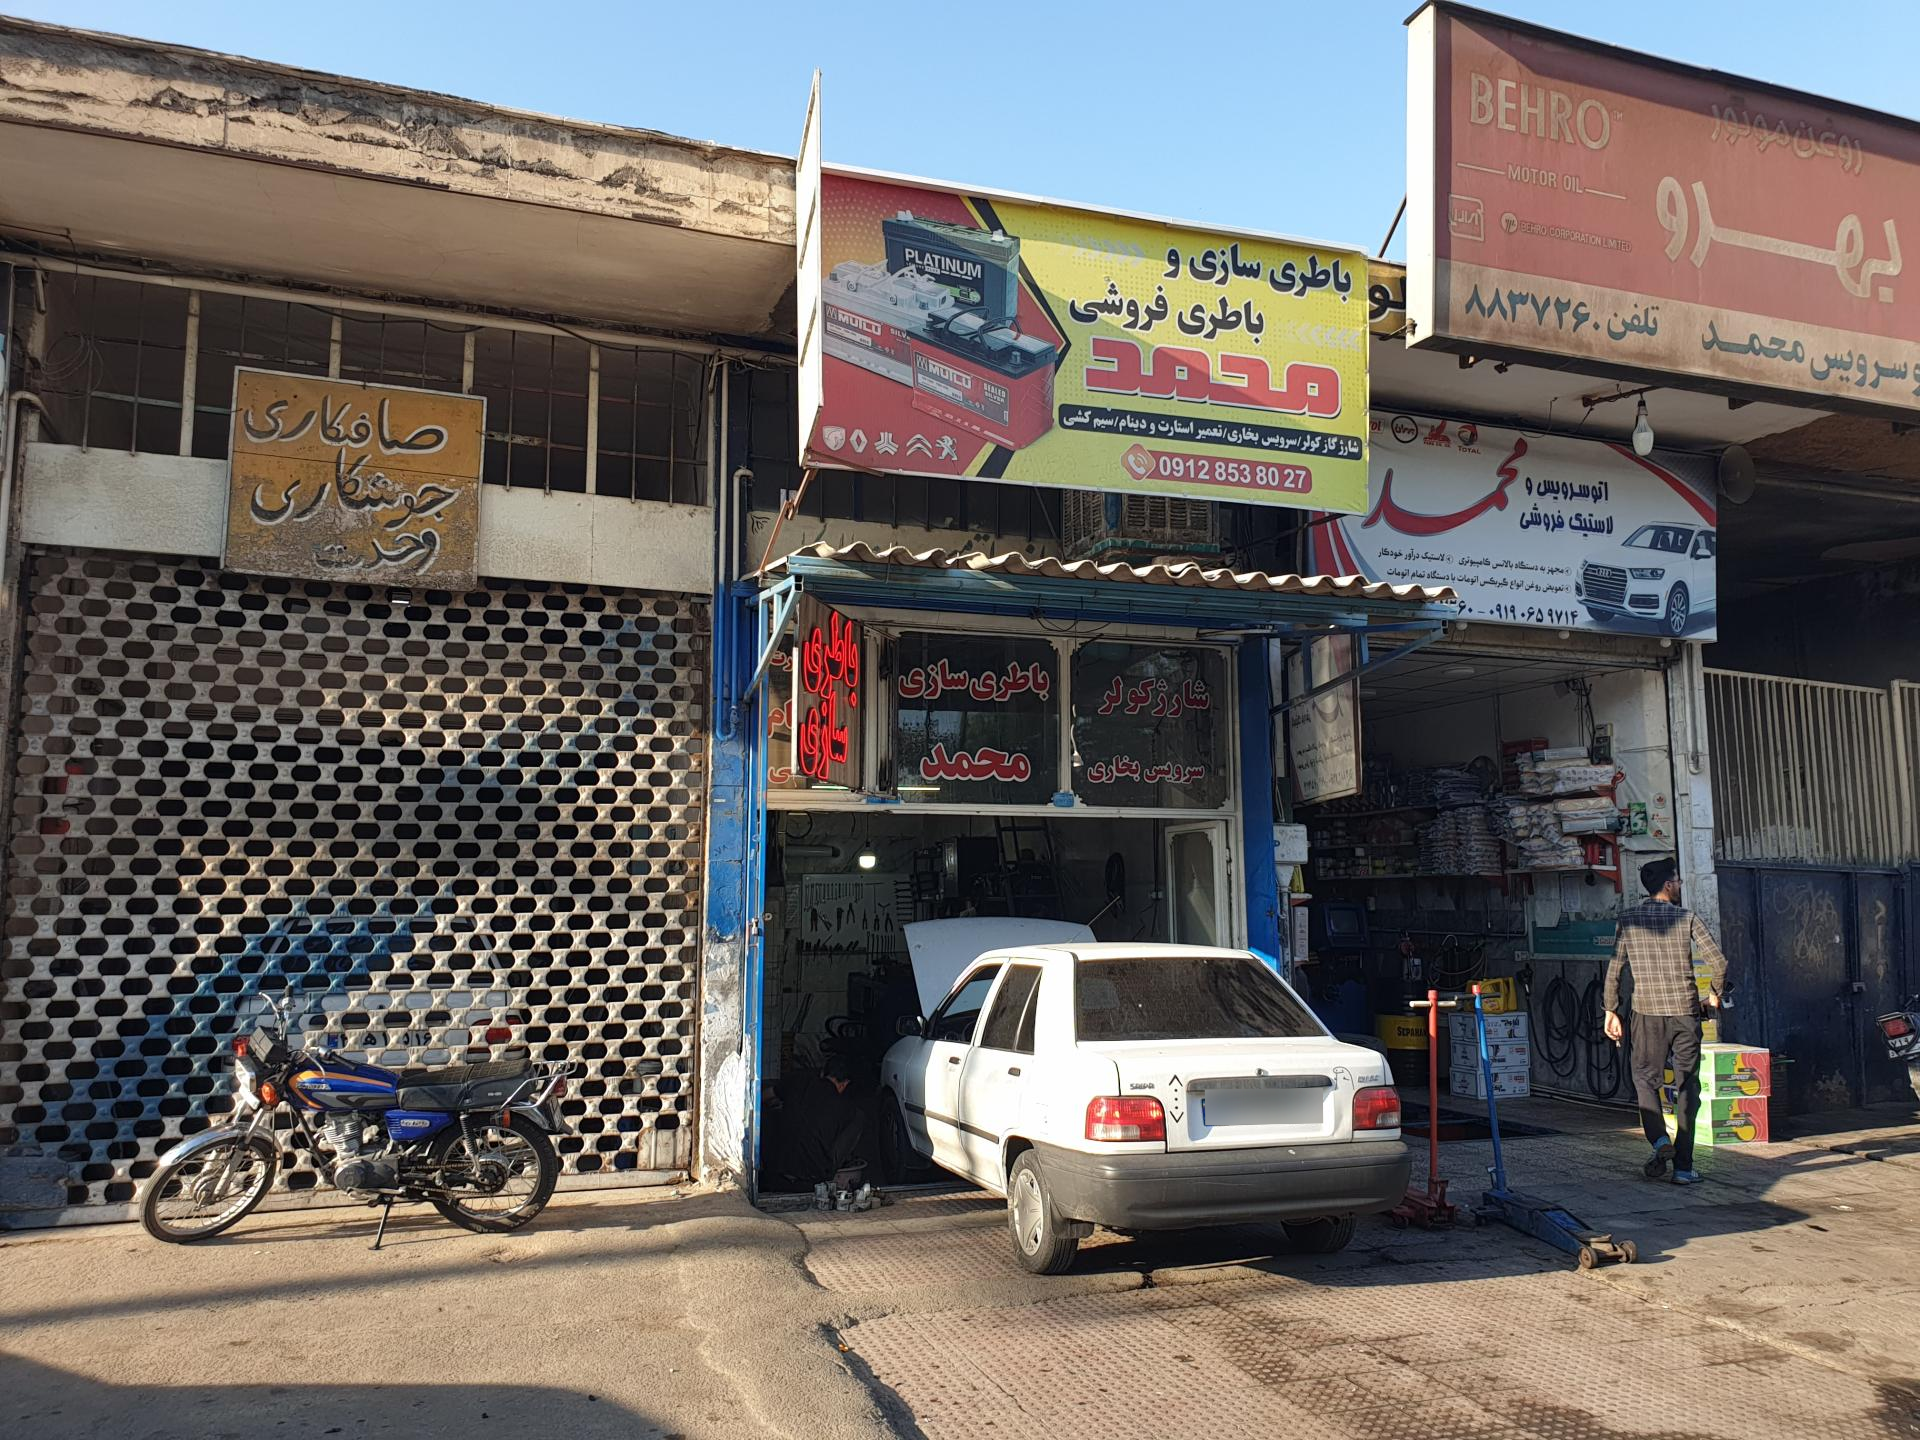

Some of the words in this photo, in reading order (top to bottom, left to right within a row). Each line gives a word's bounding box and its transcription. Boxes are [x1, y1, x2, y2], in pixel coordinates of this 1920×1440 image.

[1470, 72, 1610, 150] BEHRO
[1507, 164, 1557, 188] MOTOR
[1563, 175, 1584, 194] OIL
[1519, 221, 1548, 236] BEHRO
[1550, 227, 1602, 247] CORPORATION
[1602, 237, 1633, 253] LIMITED
[1656, 176, 1903, 304] بهرو
[904, 248, 982, 280] PLATINUM
[1163, 247, 1181, 278] و
[1188, 242, 1262, 286] سازی
[1269, 252, 1352, 303] باطری
[1069, 281, 1170, 332] فروشی
[1176, 295, 1265, 345] باطری
[1607, 304, 1660, 341] تلفن
[1701, 319, 1806, 366] محمد
[1084, 336, 1342, 418] محمد
[243, 394, 449, 456] صافکاری
[1063, 409, 1092, 426] کشی
[1150, 423, 1156, 435] و
[1158, 420, 1194, 436] استارت
[1322, 436, 1337, 453] گاز
[1338, 440, 1359, 456] شارژ
[1458, 446, 1481, 455] TOTAL
[250, 447, 460, 531] جوشکاری
[1159, 455, 1210, 480] 0912
[1214, 461, 1251, 484] 853
[1255, 465, 1280, 486] 80
[1283, 469, 1307, 489] 27
[1361, 437, 1528, 537] محمد
[1525, 477, 1533, 497] و
[1519, 503, 1564, 530] فروشی
[1569, 511, 1614, 537] لاستیک
[314, 528, 440, 576] وحدت
[1421, 551, 1445, 562] لاستیک
[1514, 560, 1539, 572] دستگاه
[1489, 603, 1516, 622] ۰۹۱۹
[1520, 607, 1544, 623] ۰۶۵
[803, 610, 859, 708] باطری
[899, 658, 969, 700] سازی
[969, 661, 1050, 701] باطری
[1152, 678, 1210, 717] شارژ
[799, 690, 848, 780] سازی
[919, 743, 1031, 782] محمد
[1087, 755, 1141, 783] بخاری
[1143, 762, 1205, 784] سرویس
